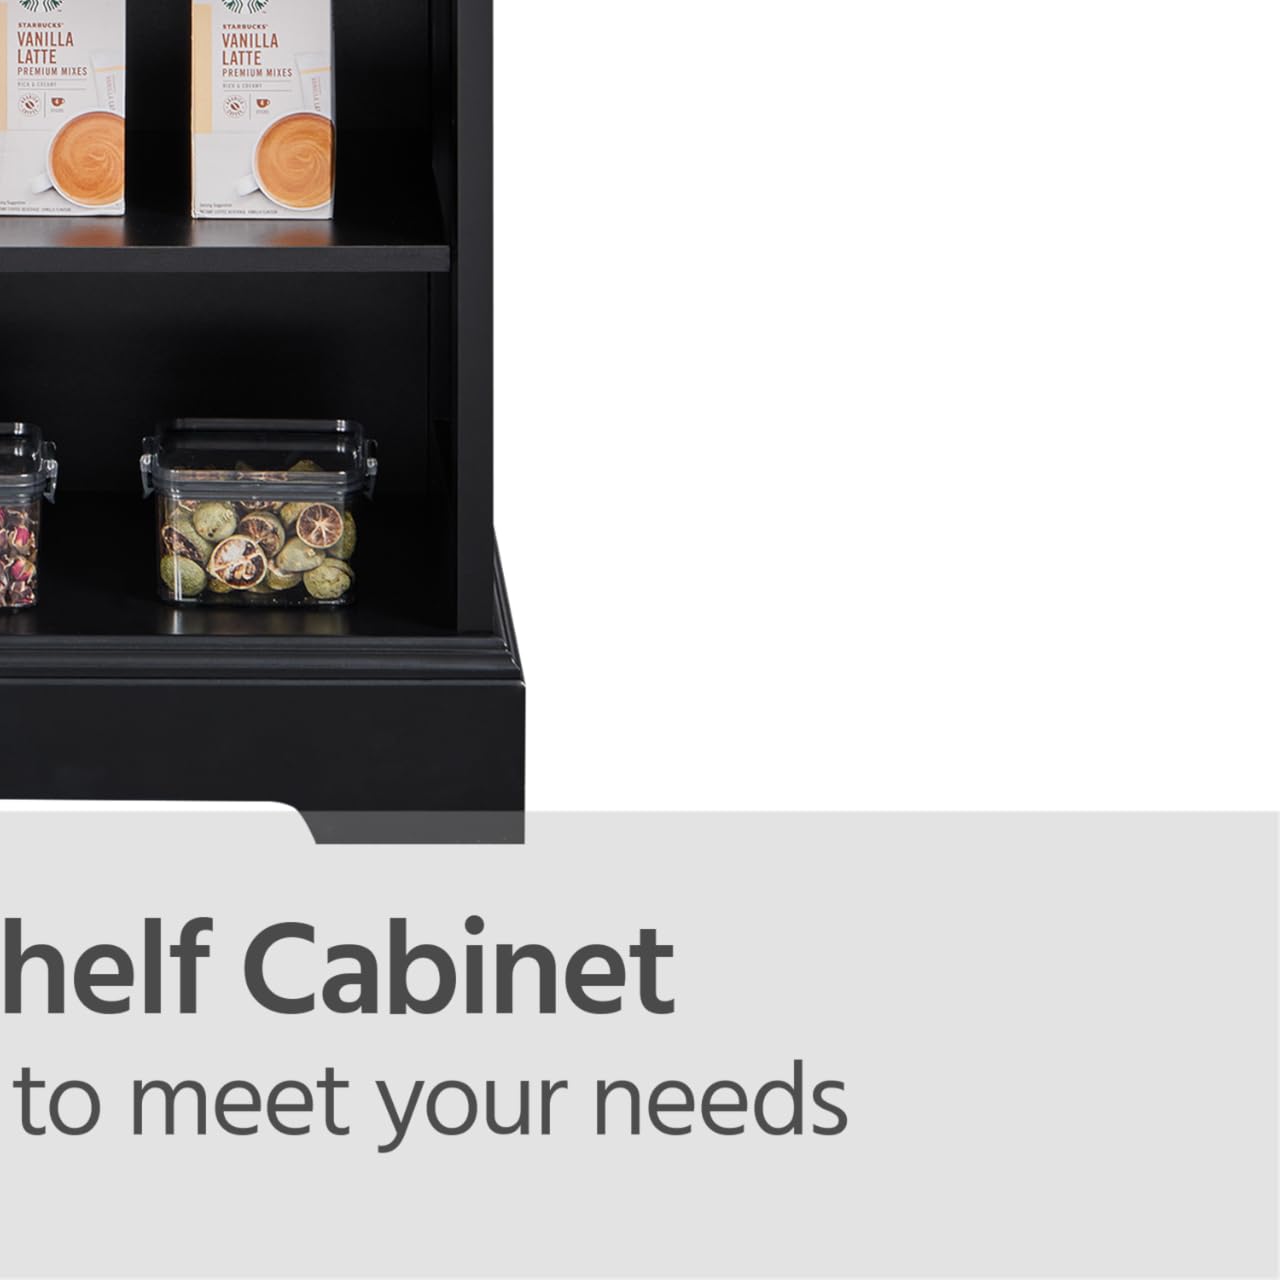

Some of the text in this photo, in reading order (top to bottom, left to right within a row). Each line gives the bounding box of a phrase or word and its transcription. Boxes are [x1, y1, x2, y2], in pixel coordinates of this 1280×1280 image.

[17, 31, 74, 47] VANILLA
[222, 33, 278, 48] VANILLA
[17, 49, 57, 64] LATTE
[222, 50, 262, 66] LATTE
[17, 67, 88, 76] PREMIUM MIXES
[222, 68, 293, 77] PREMIUM MIXES
